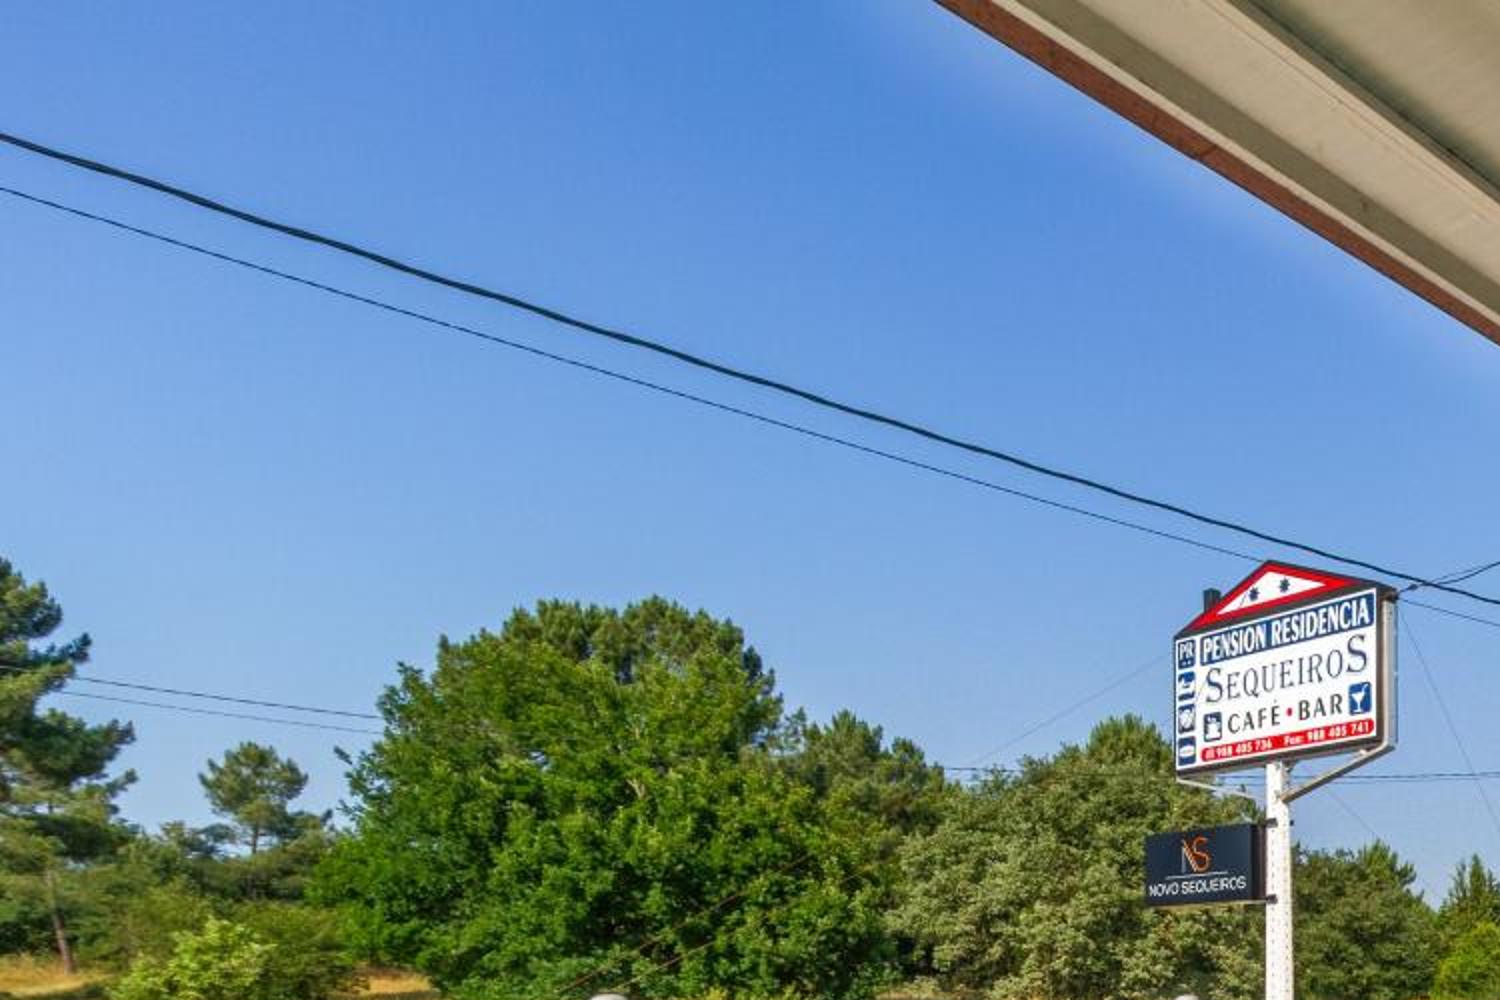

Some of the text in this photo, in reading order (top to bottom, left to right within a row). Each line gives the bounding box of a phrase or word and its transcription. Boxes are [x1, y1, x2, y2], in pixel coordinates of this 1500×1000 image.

[1203, 597, 1371, 664] PENSION RESIDENCIA
[1227, 693, 1343, 735] CAFÉ BAR
[1148, 875, 1247, 898] NOVO SEQUEIROS
